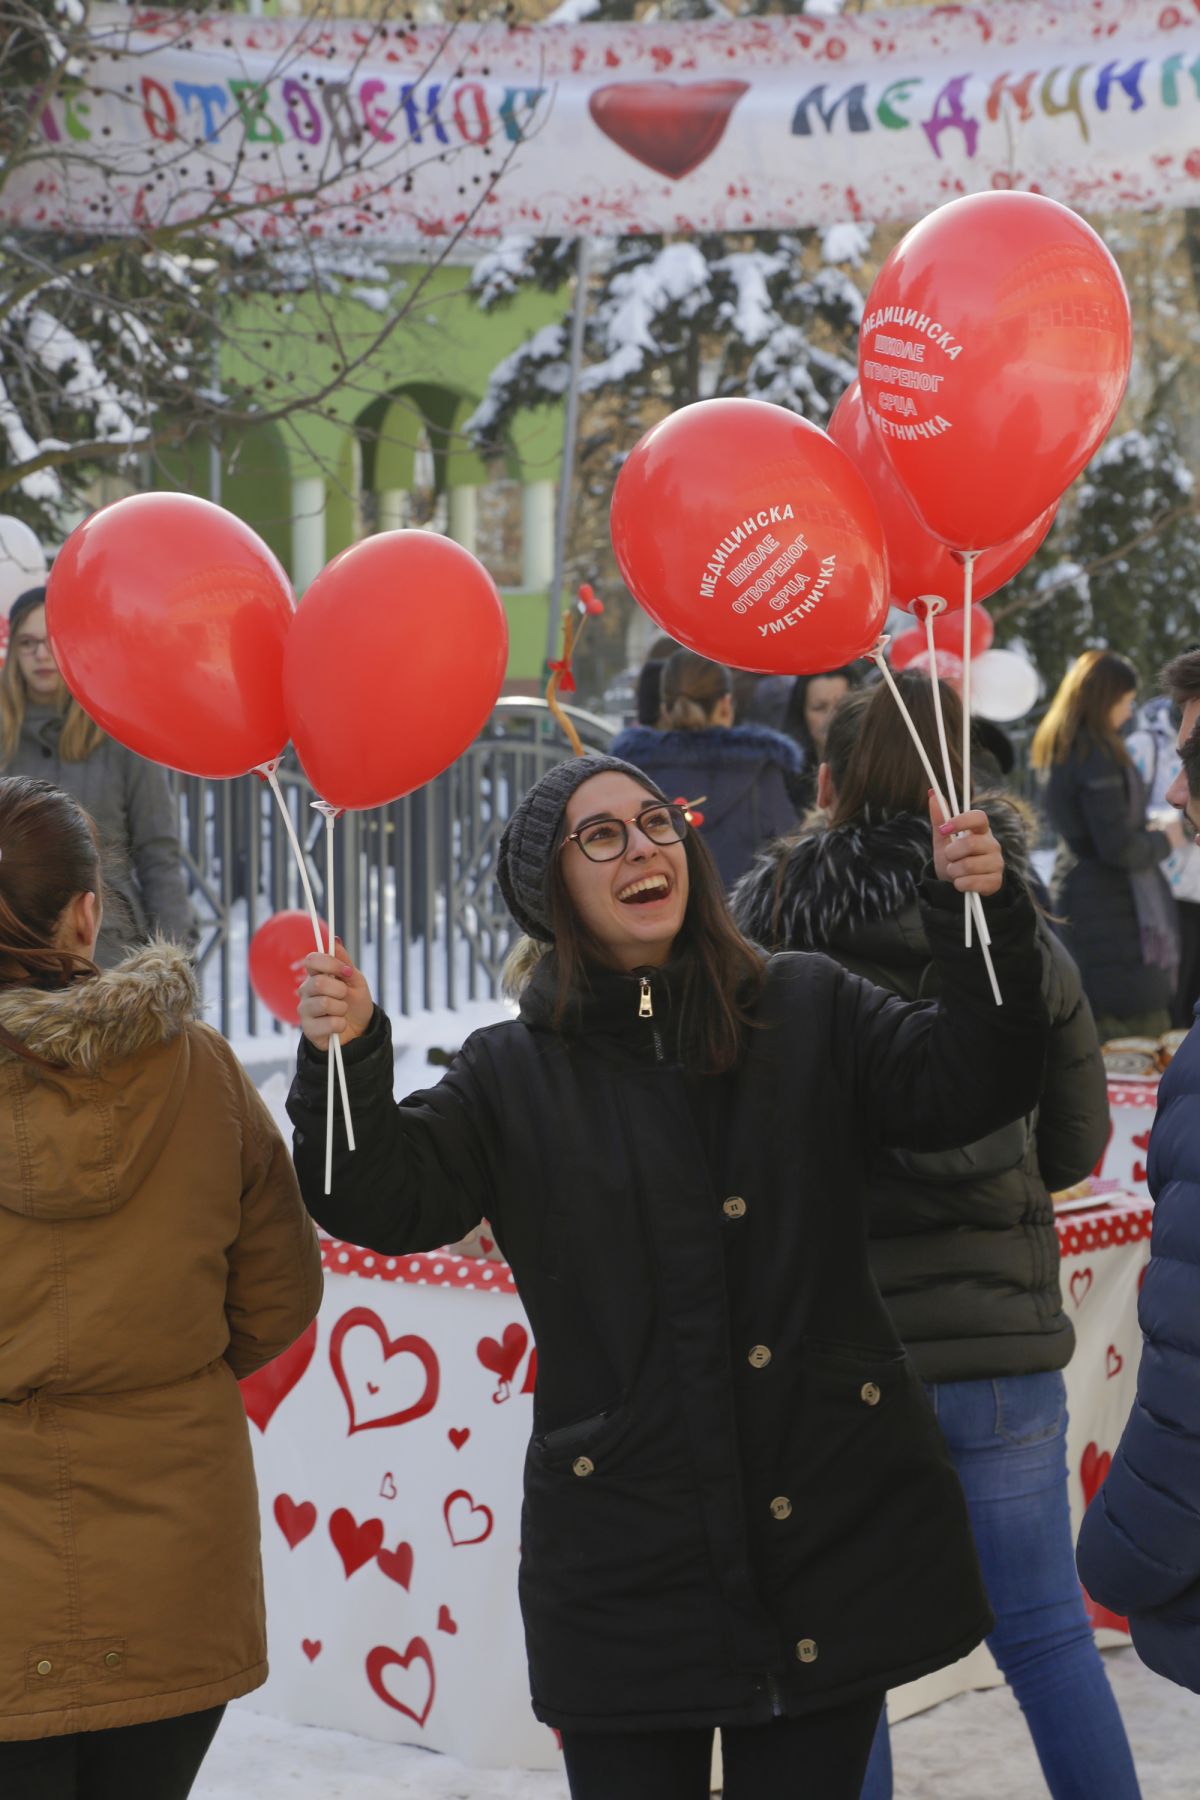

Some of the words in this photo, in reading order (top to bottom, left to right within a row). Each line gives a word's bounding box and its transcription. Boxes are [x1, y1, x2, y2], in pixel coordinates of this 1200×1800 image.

[140, 76, 546, 164] ОТВОРЕНОГ
[863, 306, 963, 361] МЕДИЦИНСКА
[874, 334, 926, 363] ШКОЛЕ
[879, 391, 918, 418] СРЦА
[699, 503, 795, 598] МЕДИЦИНСКА
[726, 533, 781, 588] ШКОЛЕ
[731, 533, 809, 615] ОТВОРЕНОГ
[757, 554, 837, 637] УМЕТНИЧКА
[769, 572, 811, 611] СРЦА
